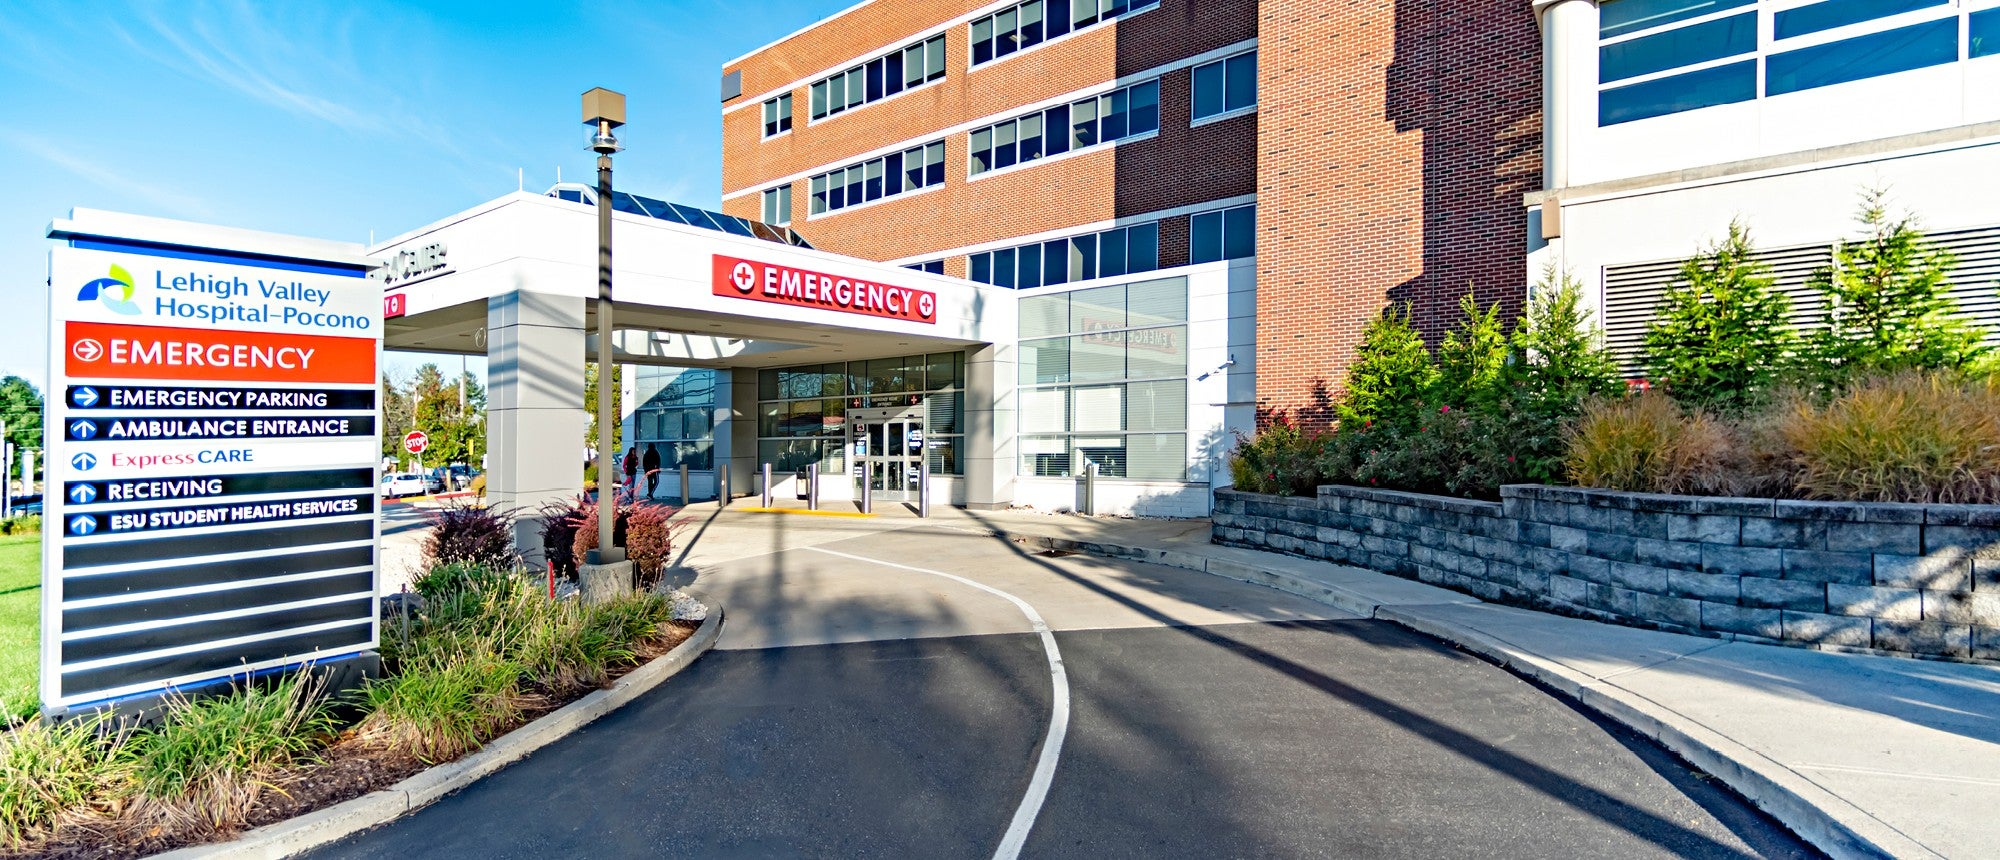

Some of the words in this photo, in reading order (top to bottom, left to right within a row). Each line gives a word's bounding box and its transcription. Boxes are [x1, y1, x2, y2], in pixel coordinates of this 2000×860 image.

[155, 270, 249, 299] Lehigh
[257, 279, 331, 307] Valley
[763, 266, 913, 313] EMERGENCY
[109, 338, 316, 369] EMERGENCY
[110, 389, 242, 407] EMERGENCY
[245, 392, 328, 407] PARKING
[108, 420, 247, 438] AMBULANCE
[252, 419, 349, 436] ENTRANCE
[406, 437, 426, 448] STOP
[108, 479, 223, 500] RECEIVING
[111, 513, 147, 530] ESU
[150, 507, 229, 527] STUDENT
[231, 502, 292, 521] HEALTH
[293, 498, 358, 516] SERVICES
